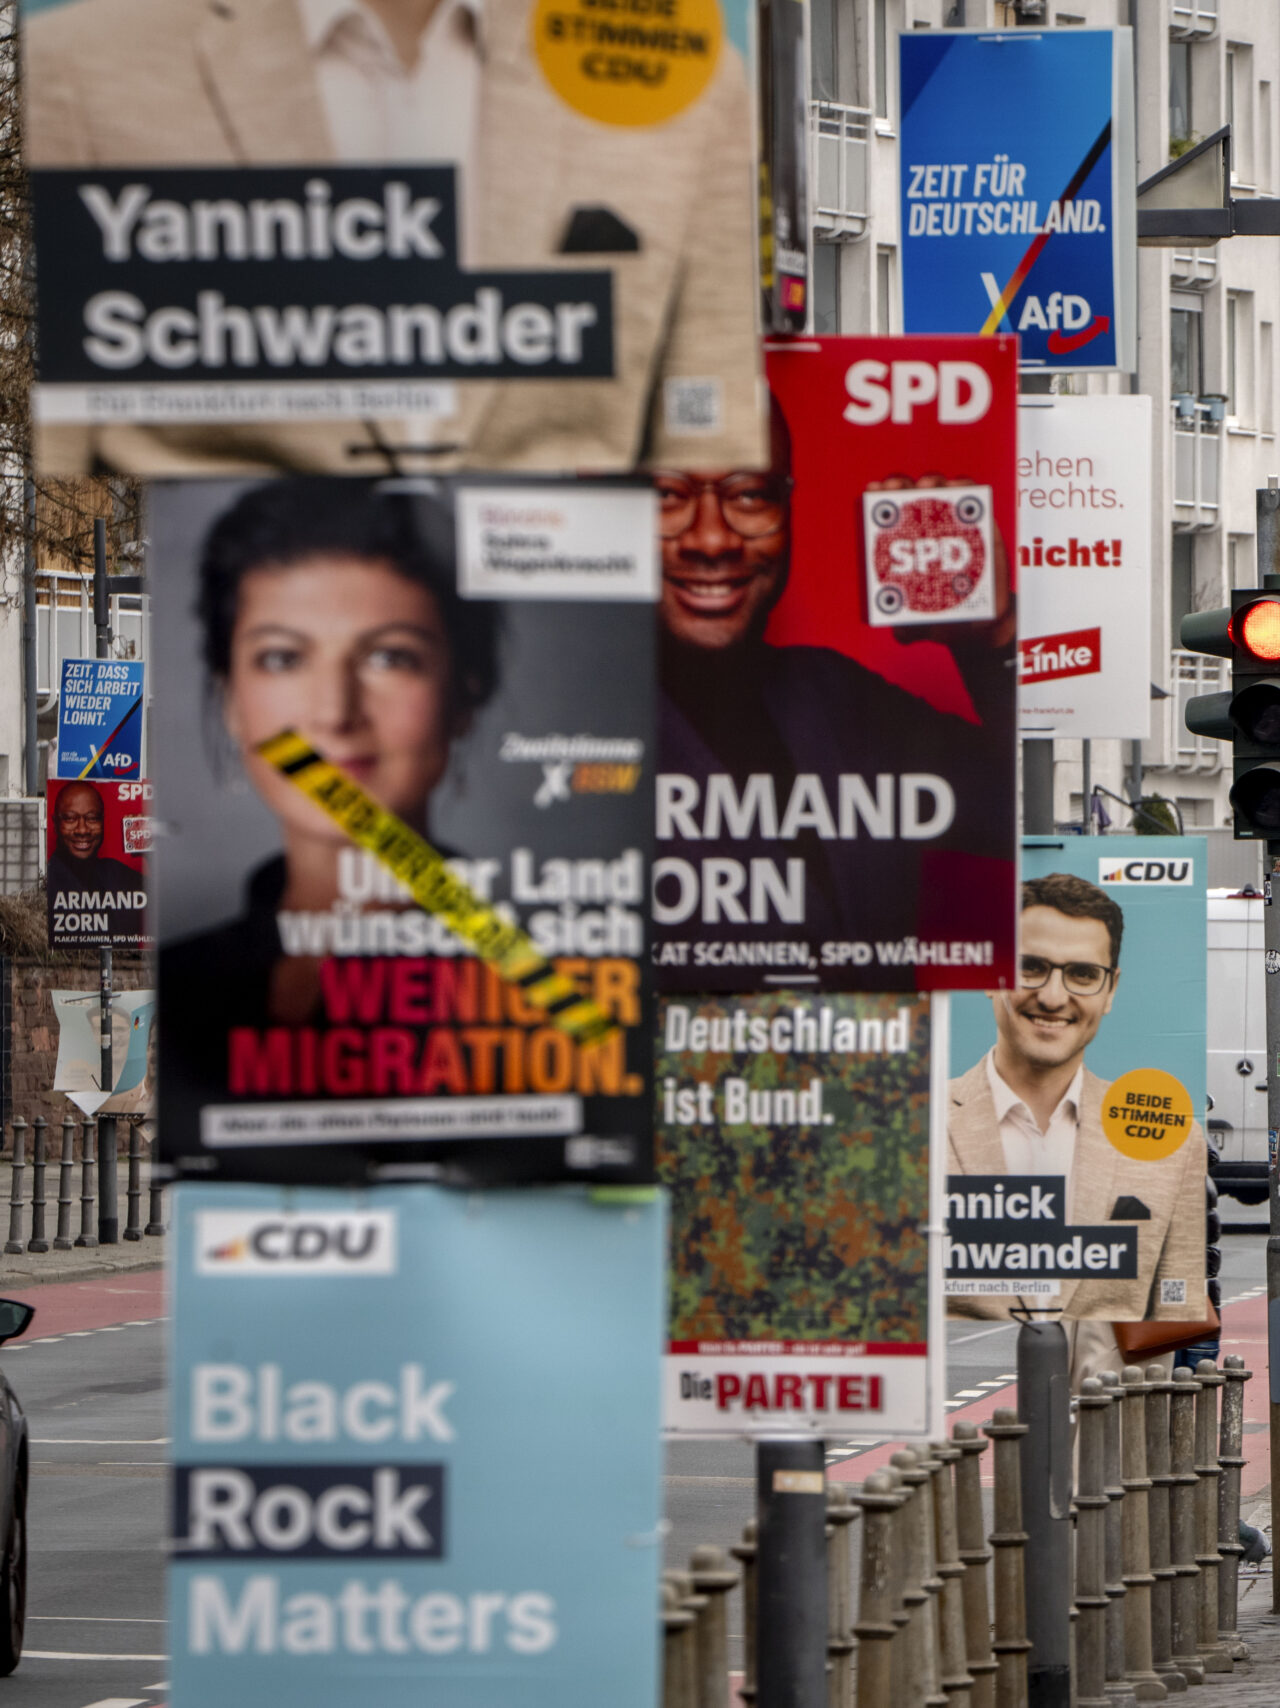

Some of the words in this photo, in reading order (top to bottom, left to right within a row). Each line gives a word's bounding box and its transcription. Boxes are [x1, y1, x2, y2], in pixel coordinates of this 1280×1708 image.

[547, 11, 709, 56] STIMMEN
[581, 52, 668, 88] CDU
[907, 164, 968, 198] ZEIT
[973, 154, 1026, 197] FÜR
[80, 181, 444, 261] Yannick
[908, 199, 1106, 237] DEUTSCHLAND.
[83, 289, 597, 368] Schwander
[1018, 292, 1092, 331] AfD
[843, 360, 993, 425] SPD
[1017, 482, 1125, 509] rechts.
[889, 537, 971, 575] SPD
[65, 664, 94, 679] ZEIT,
[97, 665, 129, 680] DASS
[1018, 643, 1093, 675] Linke
[65, 679, 93, 694] SICH
[95, 681, 140, 696] ARBEIT
[65, 695, 112, 710] WIEDER
[64, 710, 107, 726] LOHNT.
[103, 753, 132, 767] AfD
[118, 783, 154, 801] SPD
[655, 773, 956, 840] RMAND
[511, 847, 644, 902] Land
[651, 857, 806, 924] ORN
[1124, 862, 1189, 881] CDU
[53, 891, 148, 910] ARMAND
[53, 913, 109, 932] ZORN
[79, 934, 112, 944] SCANNEN,
[112, 935, 126, 943] SPD
[528, 902, 645, 956] sich
[694, 940, 818, 969] SCANNEN,
[821, 940, 873, 966] SPD
[876, 935, 994, 966] WÄHLEN!
[664, 1005, 910, 1053] Deutschland
[228, 1026, 645, 1097] MIGRATION.
[663, 1078, 715, 1125] ist
[723, 1077, 834, 1126] Bund.
[1109, 1106, 1186, 1127] STIMMEN
[1125, 1092, 1173, 1109] BEIDE
[1124, 1124, 1166, 1140] CDU
[250, 1222, 379, 1260] CDU
[978, 1280, 1009, 1293] nach
[1012, 1279, 1051, 1293] Berlin
[191, 1363, 457, 1444] Black
[680, 1371, 711, 1400] Die
[715, 1373, 885, 1412] PARTEI
[188, 1468, 433, 1552] Rock
[188, 1575, 558, 1656] Matters
